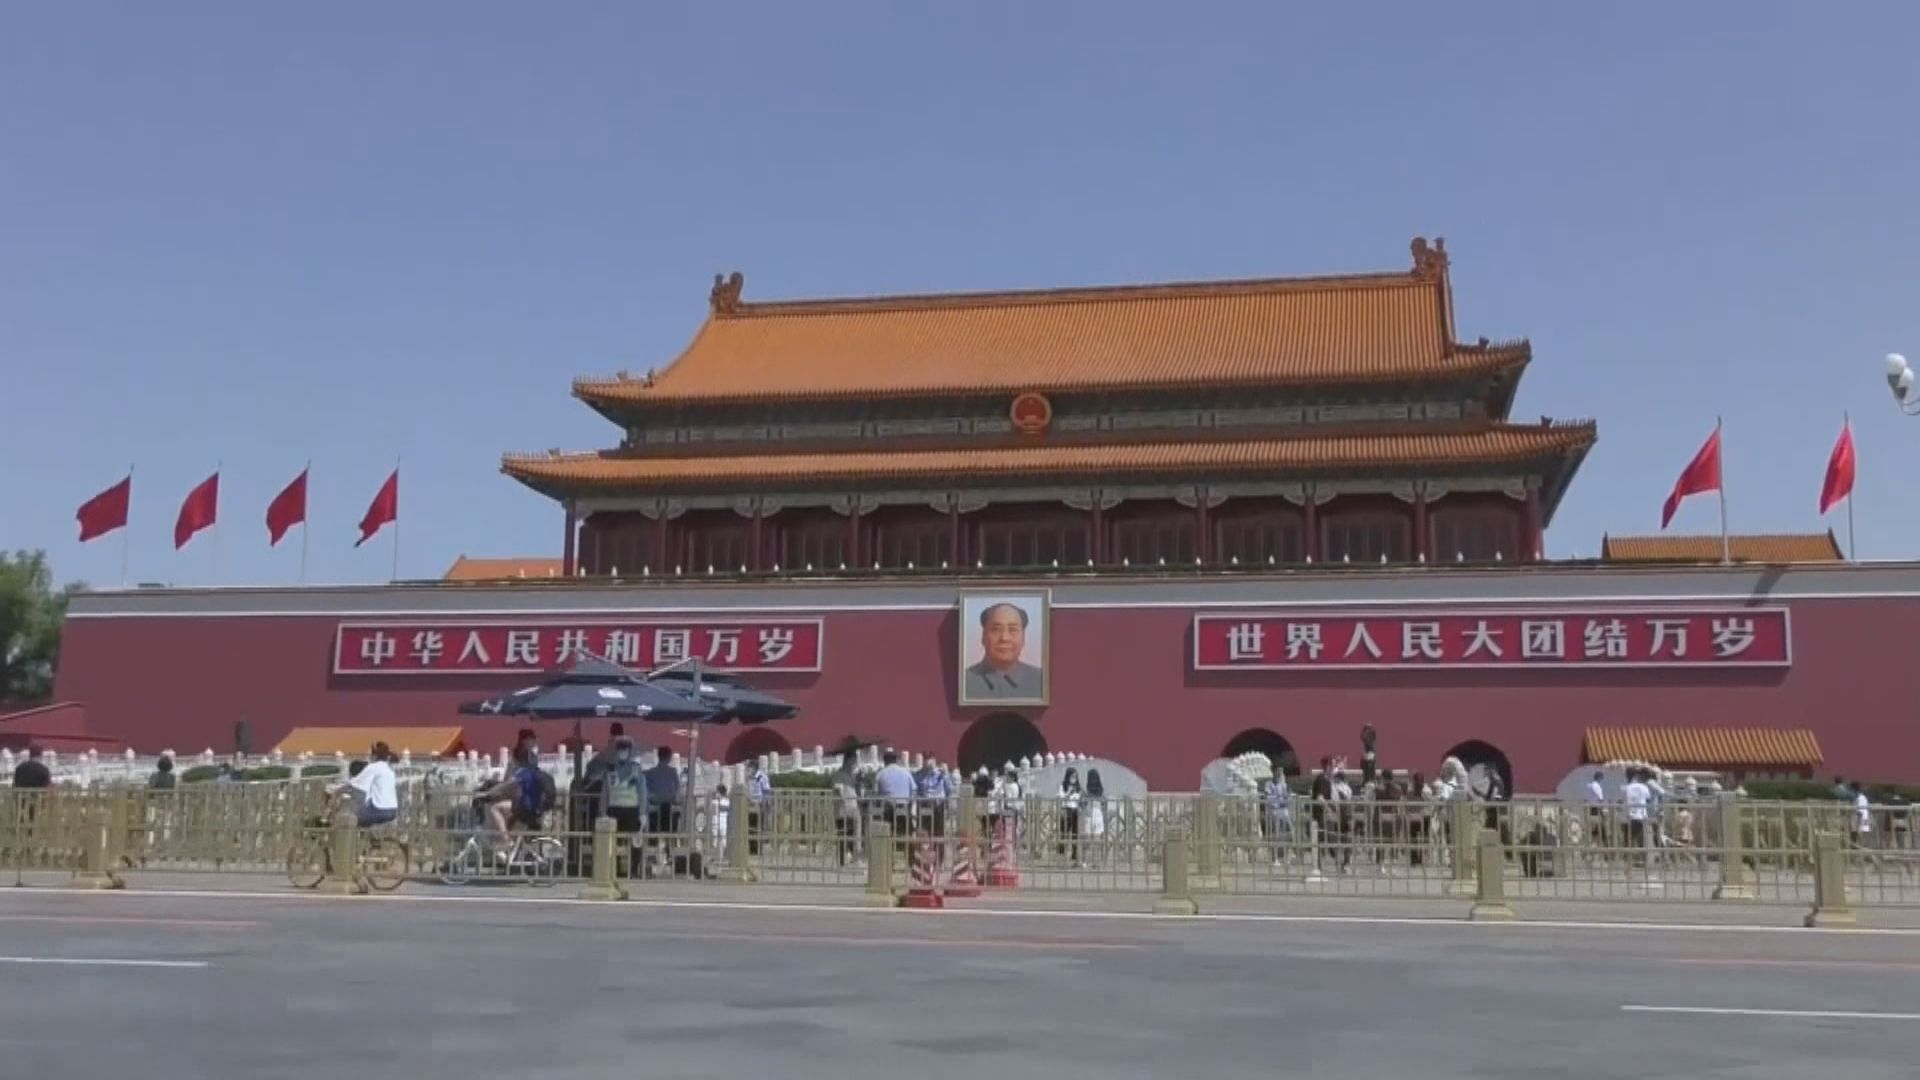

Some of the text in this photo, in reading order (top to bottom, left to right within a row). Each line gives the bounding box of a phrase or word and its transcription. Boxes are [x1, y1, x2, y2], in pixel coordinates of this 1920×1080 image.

[361, 628, 795, 666] 中华人民共和国万岁
[1226, 618, 1757, 660] 世界人民大团结万岁
